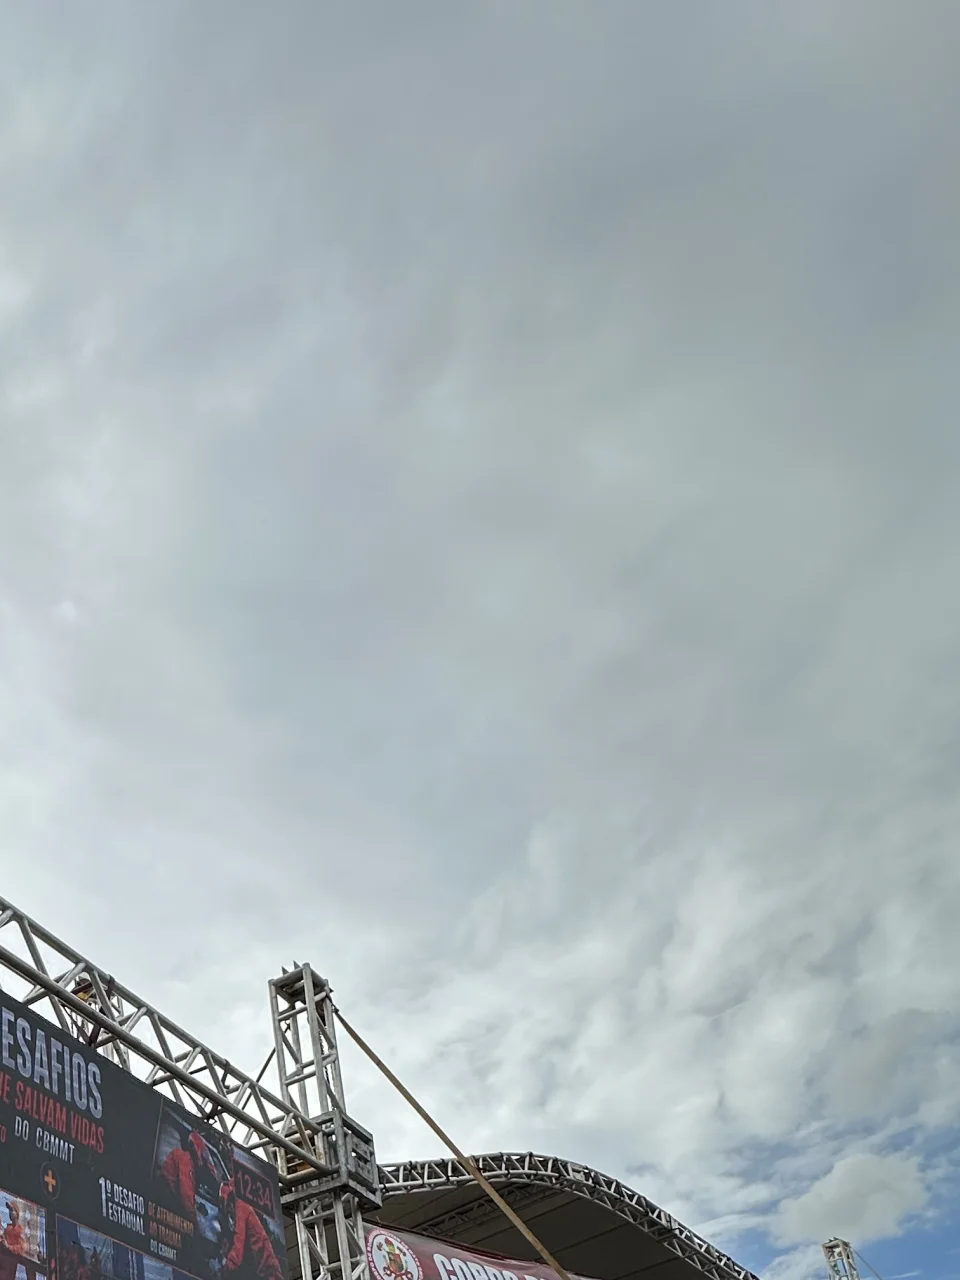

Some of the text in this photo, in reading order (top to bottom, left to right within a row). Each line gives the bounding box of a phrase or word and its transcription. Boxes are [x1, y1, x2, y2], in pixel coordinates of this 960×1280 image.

[15, 1081, 67, 1134] SALVAM
[71, 1110, 104, 1153] VIDAS
[15, 1116, 74, 1164] DO CBMMT
[99, 1176, 145, 1217] 1º DESAFIO
[108, 1202, 145, 1236] ESTADUAL
[147, 1201, 194, 1237] DE ATENDIMENTO
[150, 1239, 158, 1251] DO
